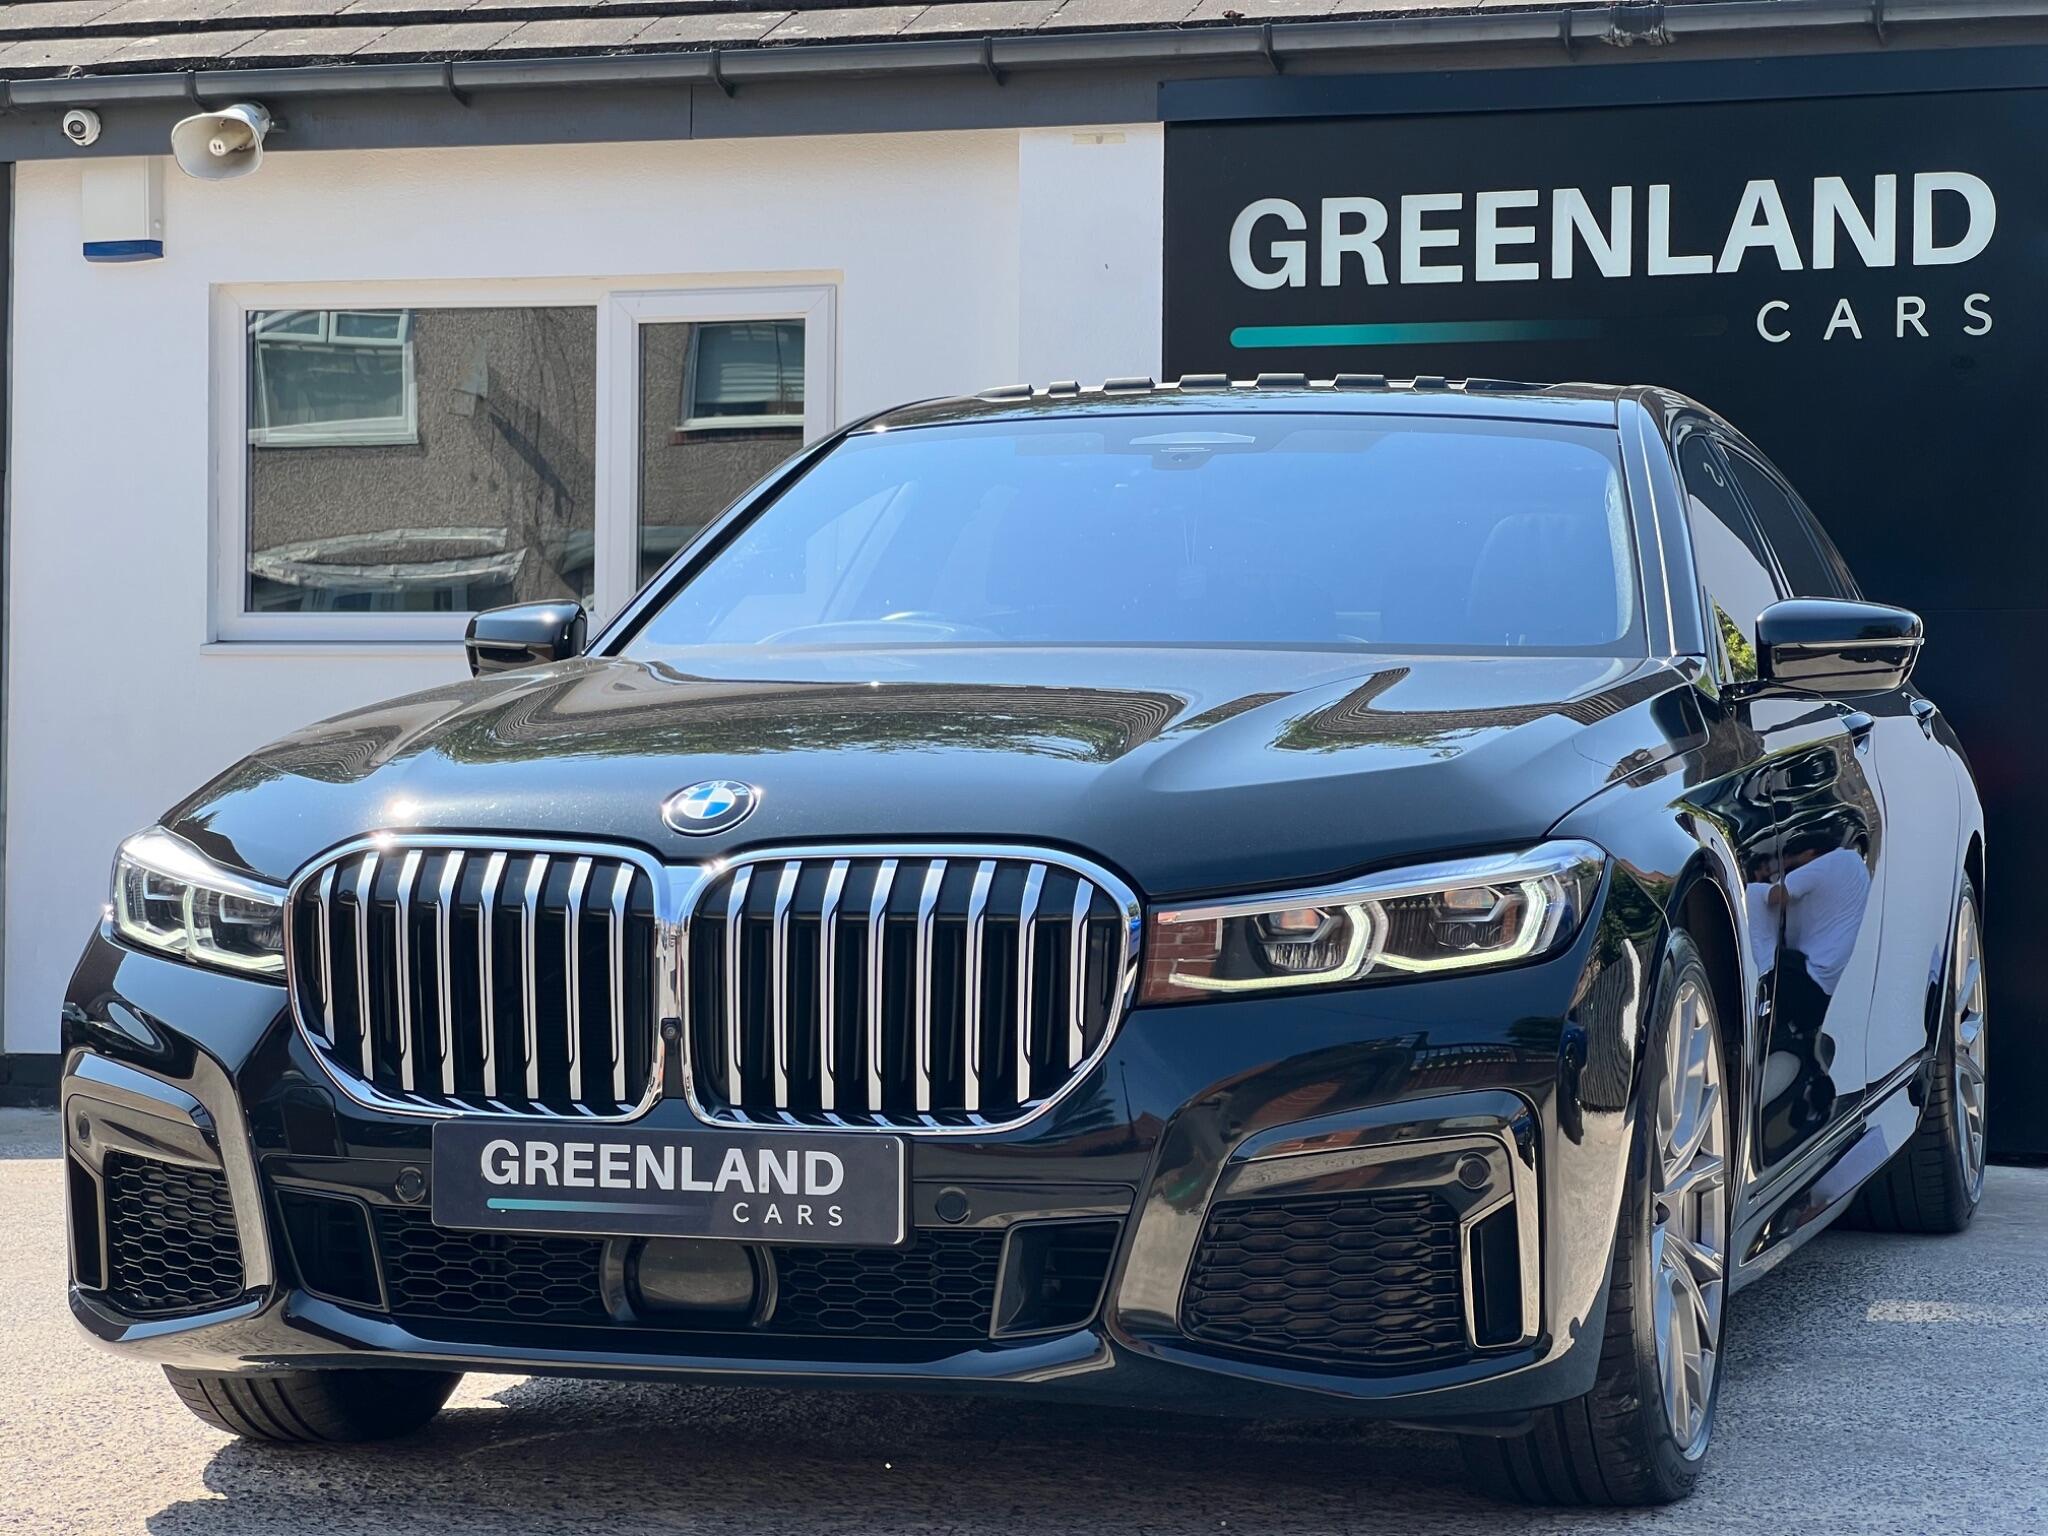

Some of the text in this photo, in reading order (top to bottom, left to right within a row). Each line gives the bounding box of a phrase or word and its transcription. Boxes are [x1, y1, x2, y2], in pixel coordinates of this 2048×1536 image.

[1230, 172, 1997, 290] GREENLAND
[1756, 293, 1993, 343] CARS
[481, 1140, 845, 1196] GREENLAND
[732, 1202, 844, 1228] CARS
